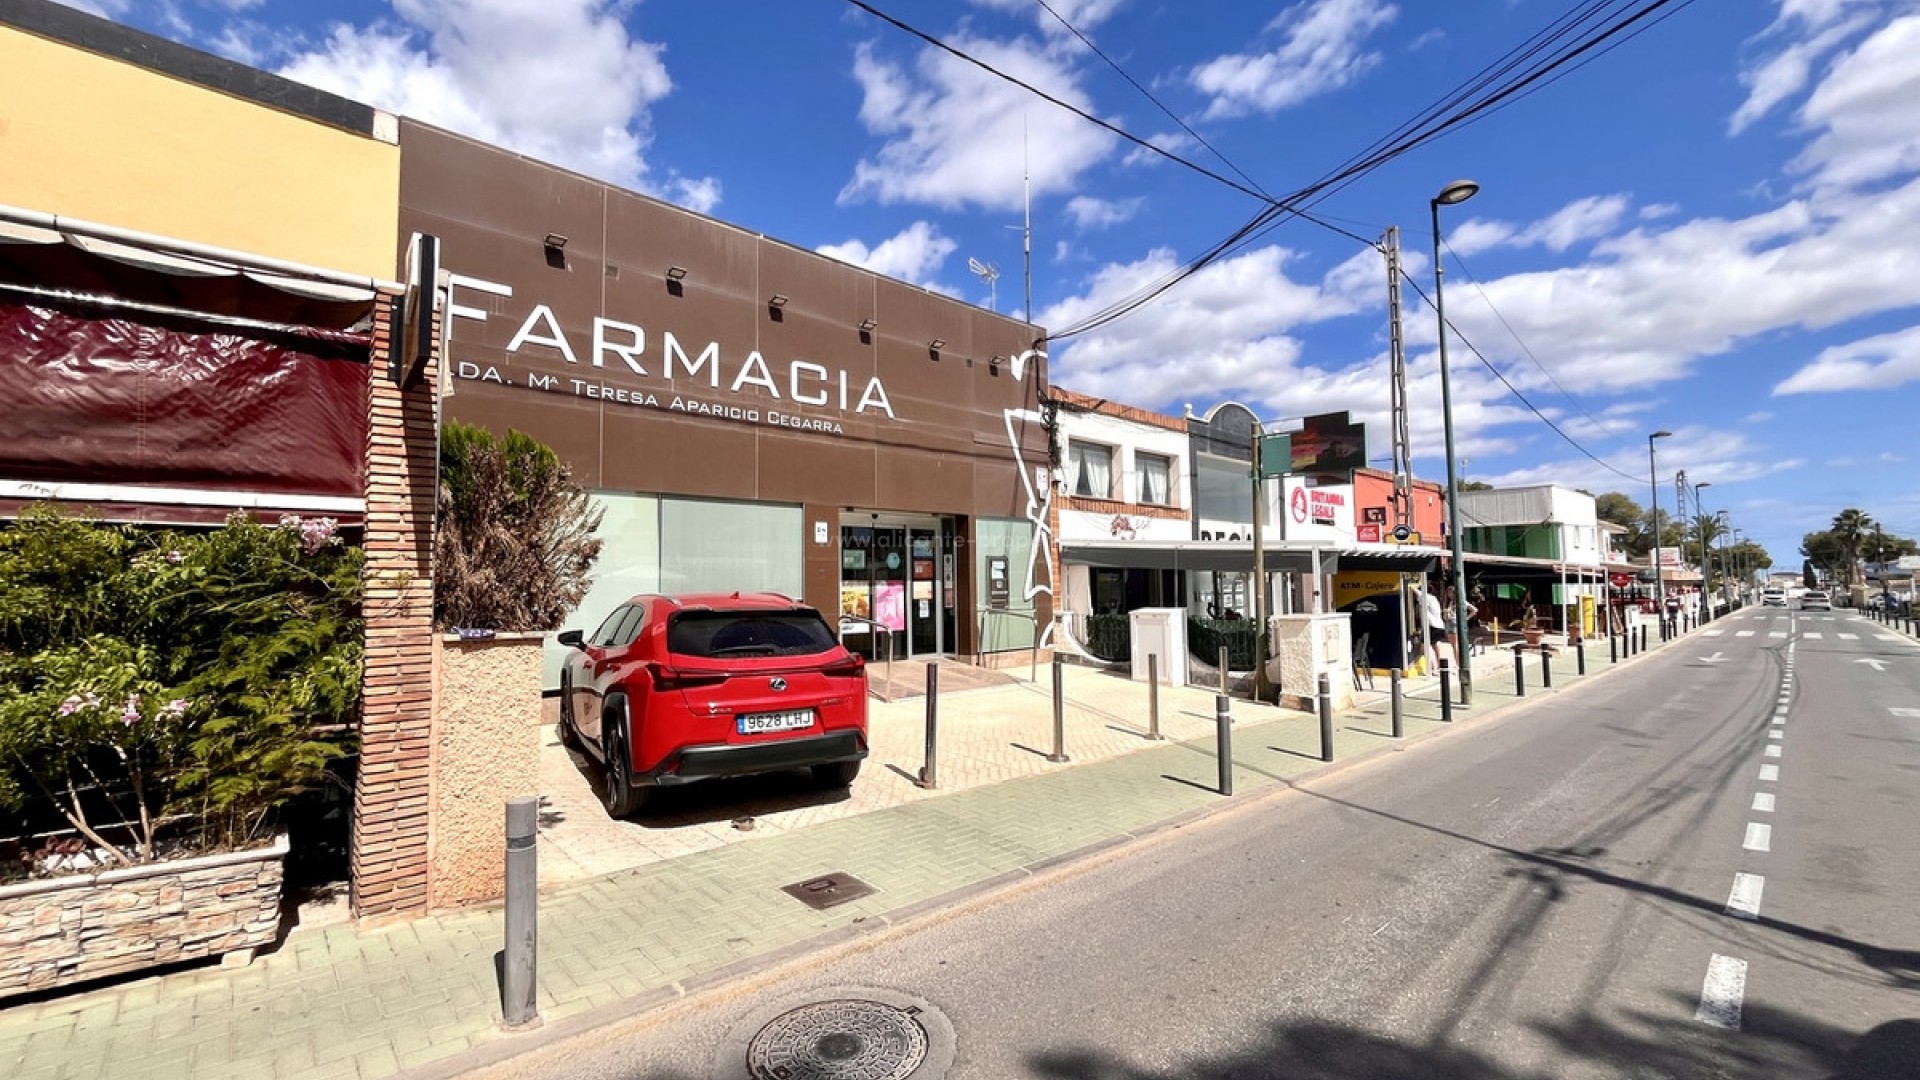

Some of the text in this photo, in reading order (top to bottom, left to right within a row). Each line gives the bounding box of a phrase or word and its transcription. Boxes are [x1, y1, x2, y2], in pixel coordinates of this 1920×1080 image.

[448, 273, 895, 420] FARMACIA
[450, 361, 513, 385] DA.
[570, 378, 659, 407] TERESA
[669, 396, 760, 422] APARICIO
[767, 410, 844, 434] CEGARRA
[747, 710, 811, 730] 9628 LHJ
